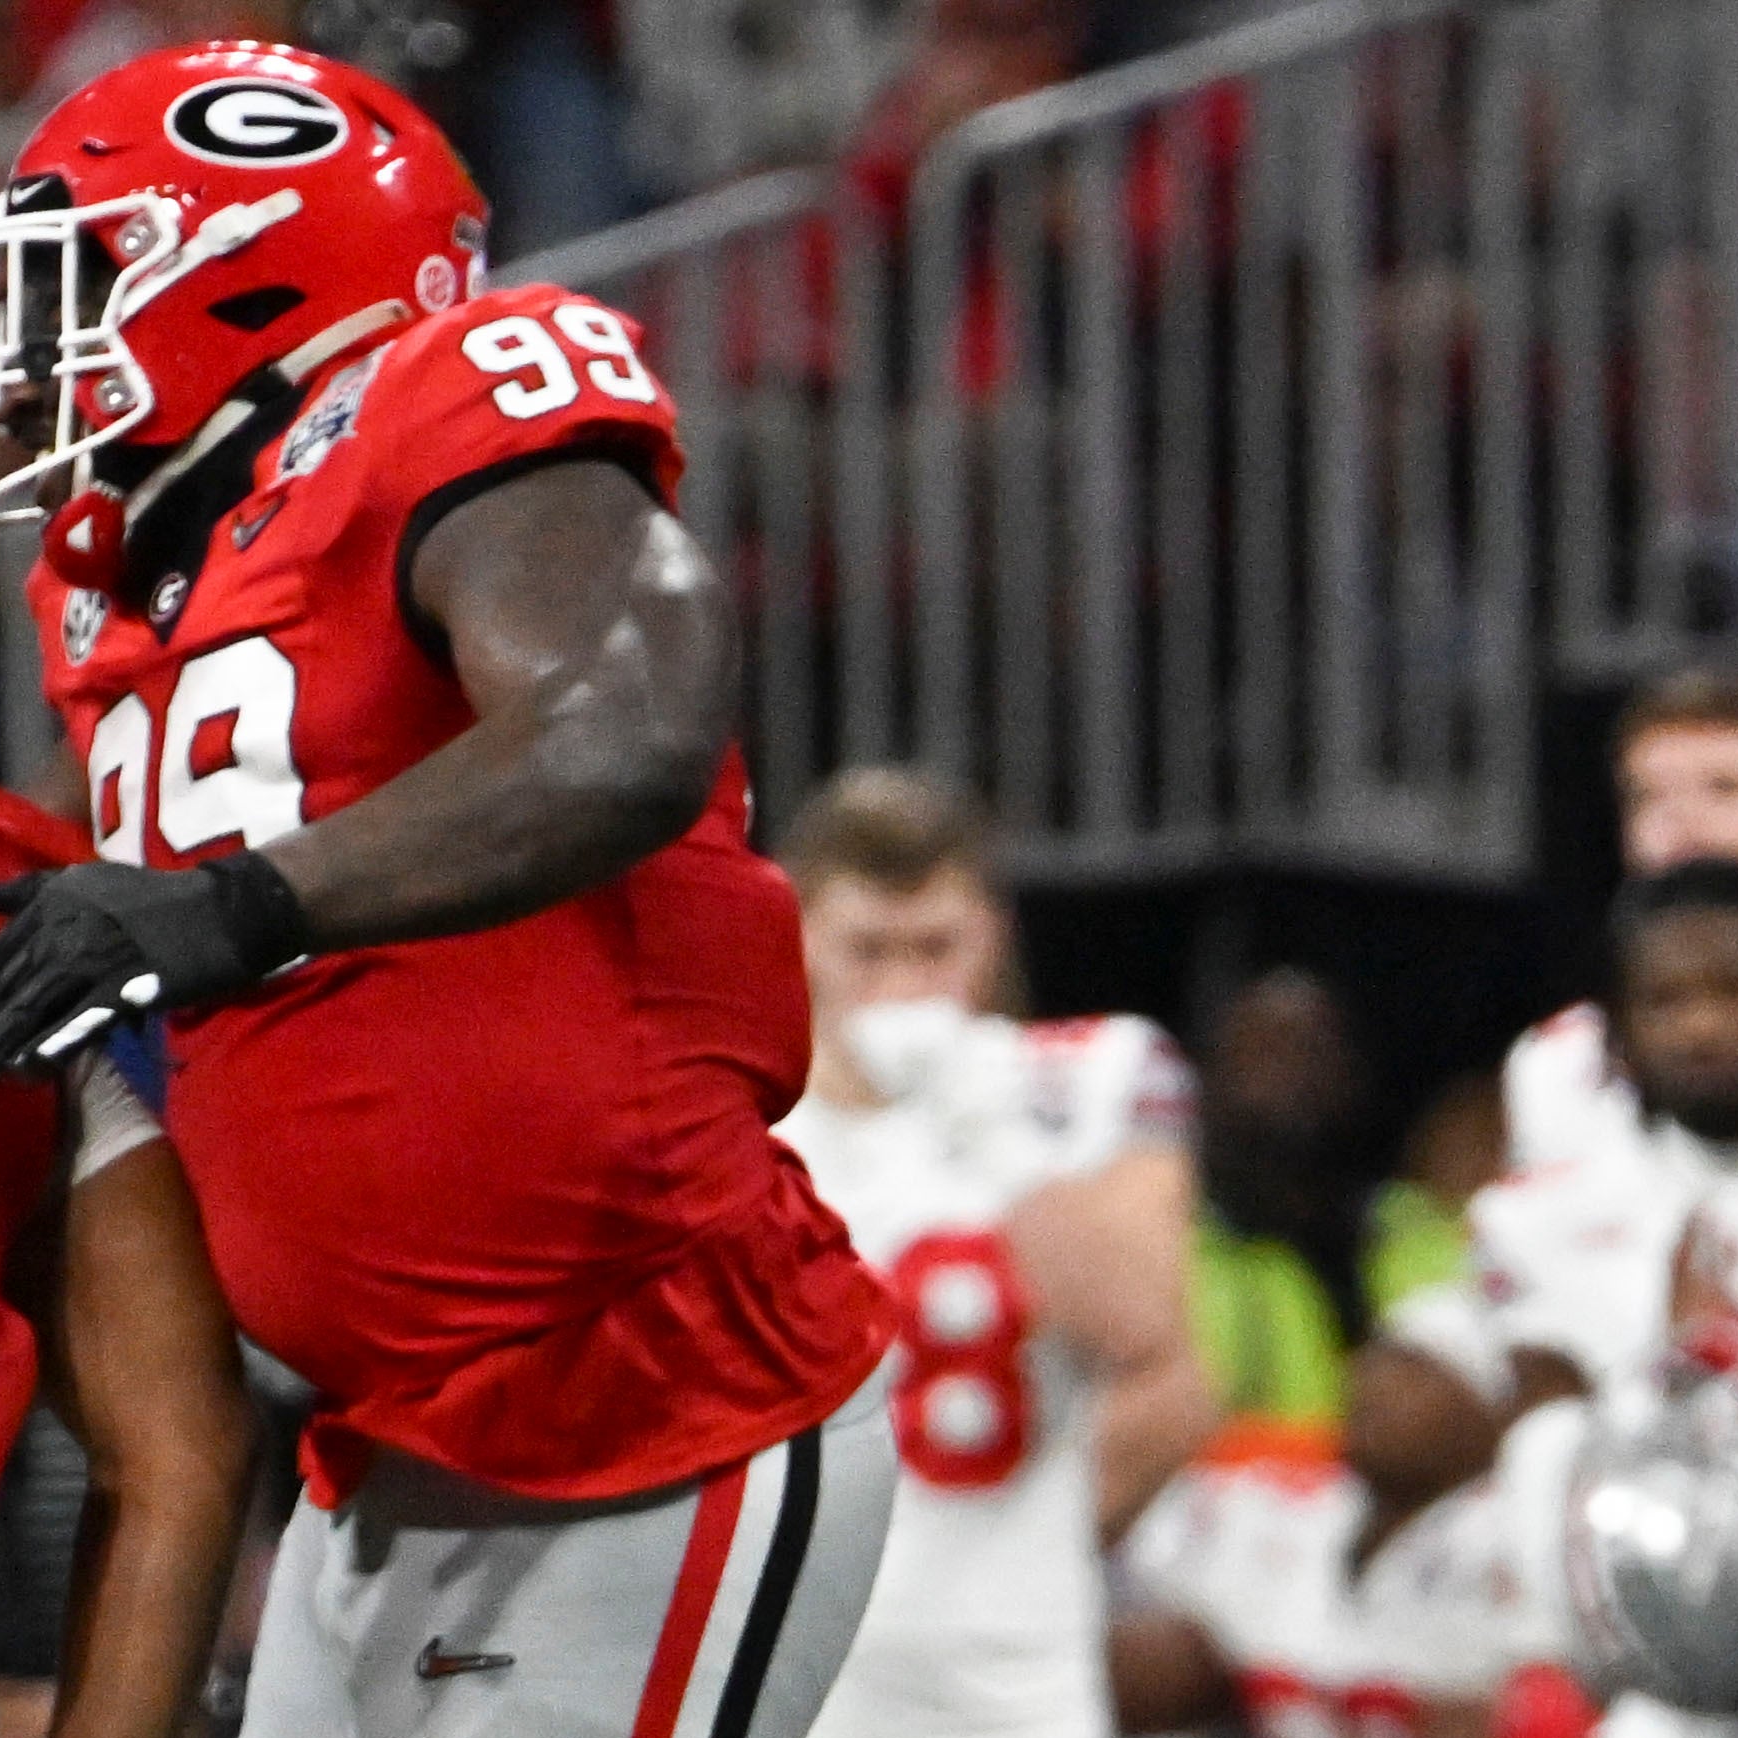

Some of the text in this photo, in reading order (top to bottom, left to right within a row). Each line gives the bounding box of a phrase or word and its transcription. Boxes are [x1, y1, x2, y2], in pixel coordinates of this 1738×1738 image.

[169, 82, 343, 164] G
[462, 303, 660, 421] 99
[87, 634, 305, 868] 99
[893, 1230, 1033, 1490] 8
